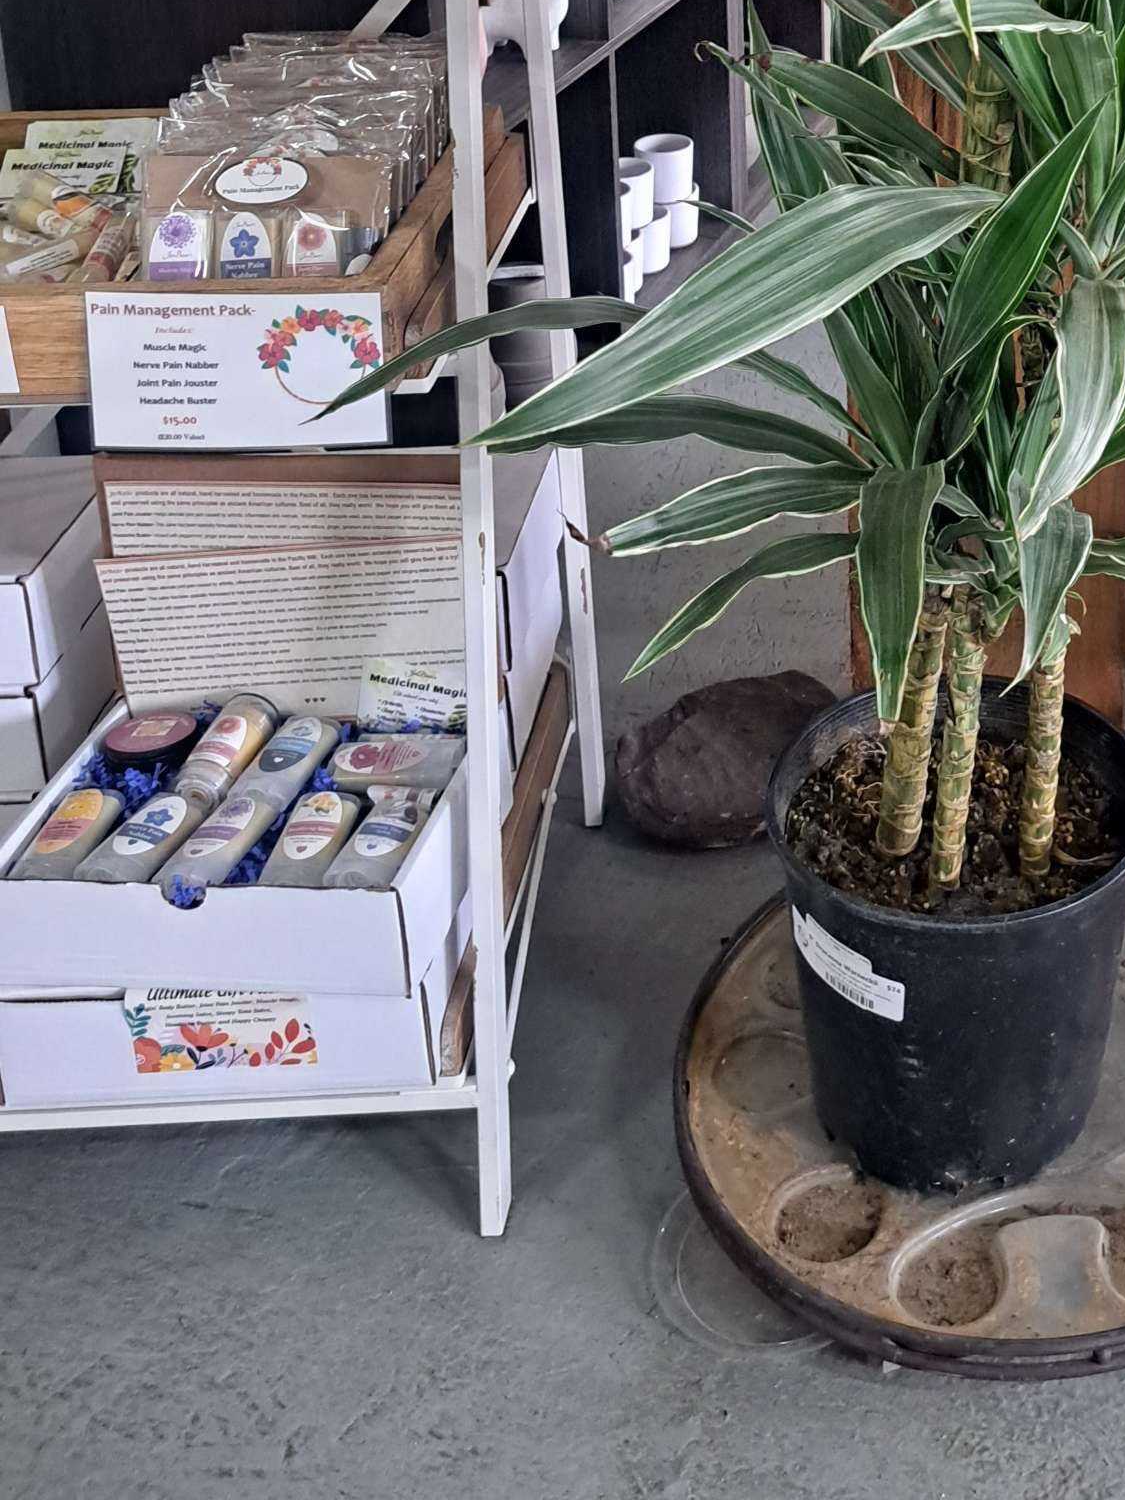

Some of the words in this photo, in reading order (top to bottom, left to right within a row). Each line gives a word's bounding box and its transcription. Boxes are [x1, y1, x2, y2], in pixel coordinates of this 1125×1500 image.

[38, 141, 95, 149] Medicinal
[11, 161, 73, 170] Medicinal
[76, 160, 114, 170] Magic
[90, 303, 119, 315] Pain
[123, 304, 216, 319] Management
[219, 304, 256, 316] Pack-
[143, 343, 176, 351] Muscle
[178, 343, 206, 353] Magic
[163, 361, 183, 369] Pain
[185, 361, 219, 369] Nabber
[137, 380, 159, 388] Joint
[184, 380, 218, 388] Jouster
[140, 397, 184, 405] Headache
[163, 416, 197, 426] $15.00
[370, 673, 431, 692] Medicinal
